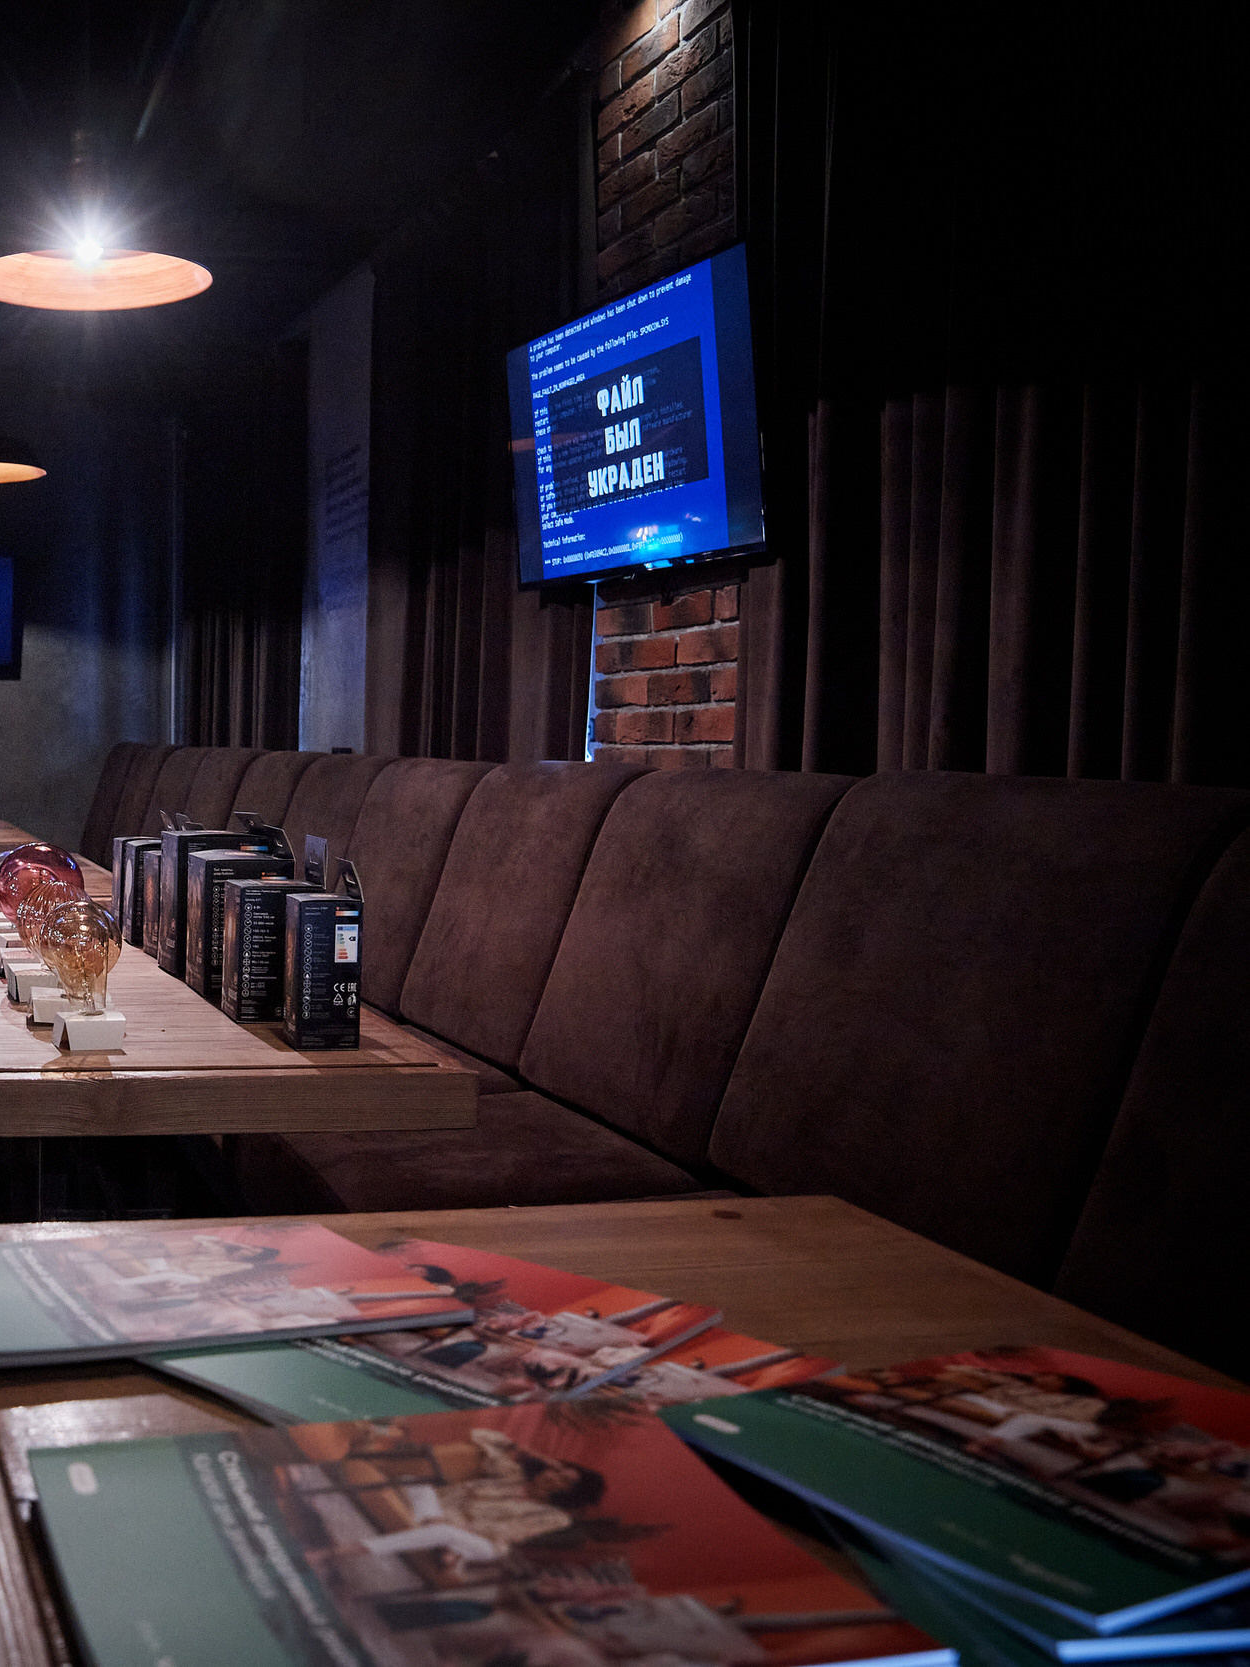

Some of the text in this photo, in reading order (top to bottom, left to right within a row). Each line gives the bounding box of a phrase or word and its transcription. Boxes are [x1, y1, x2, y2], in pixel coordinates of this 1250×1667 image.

[604, 335, 626, 350] following
[596, 374, 644, 417] ФАЙЛ
[604, 417, 641, 455] БЫЛ
[587, 451, 665, 498] УКРАДЕН
